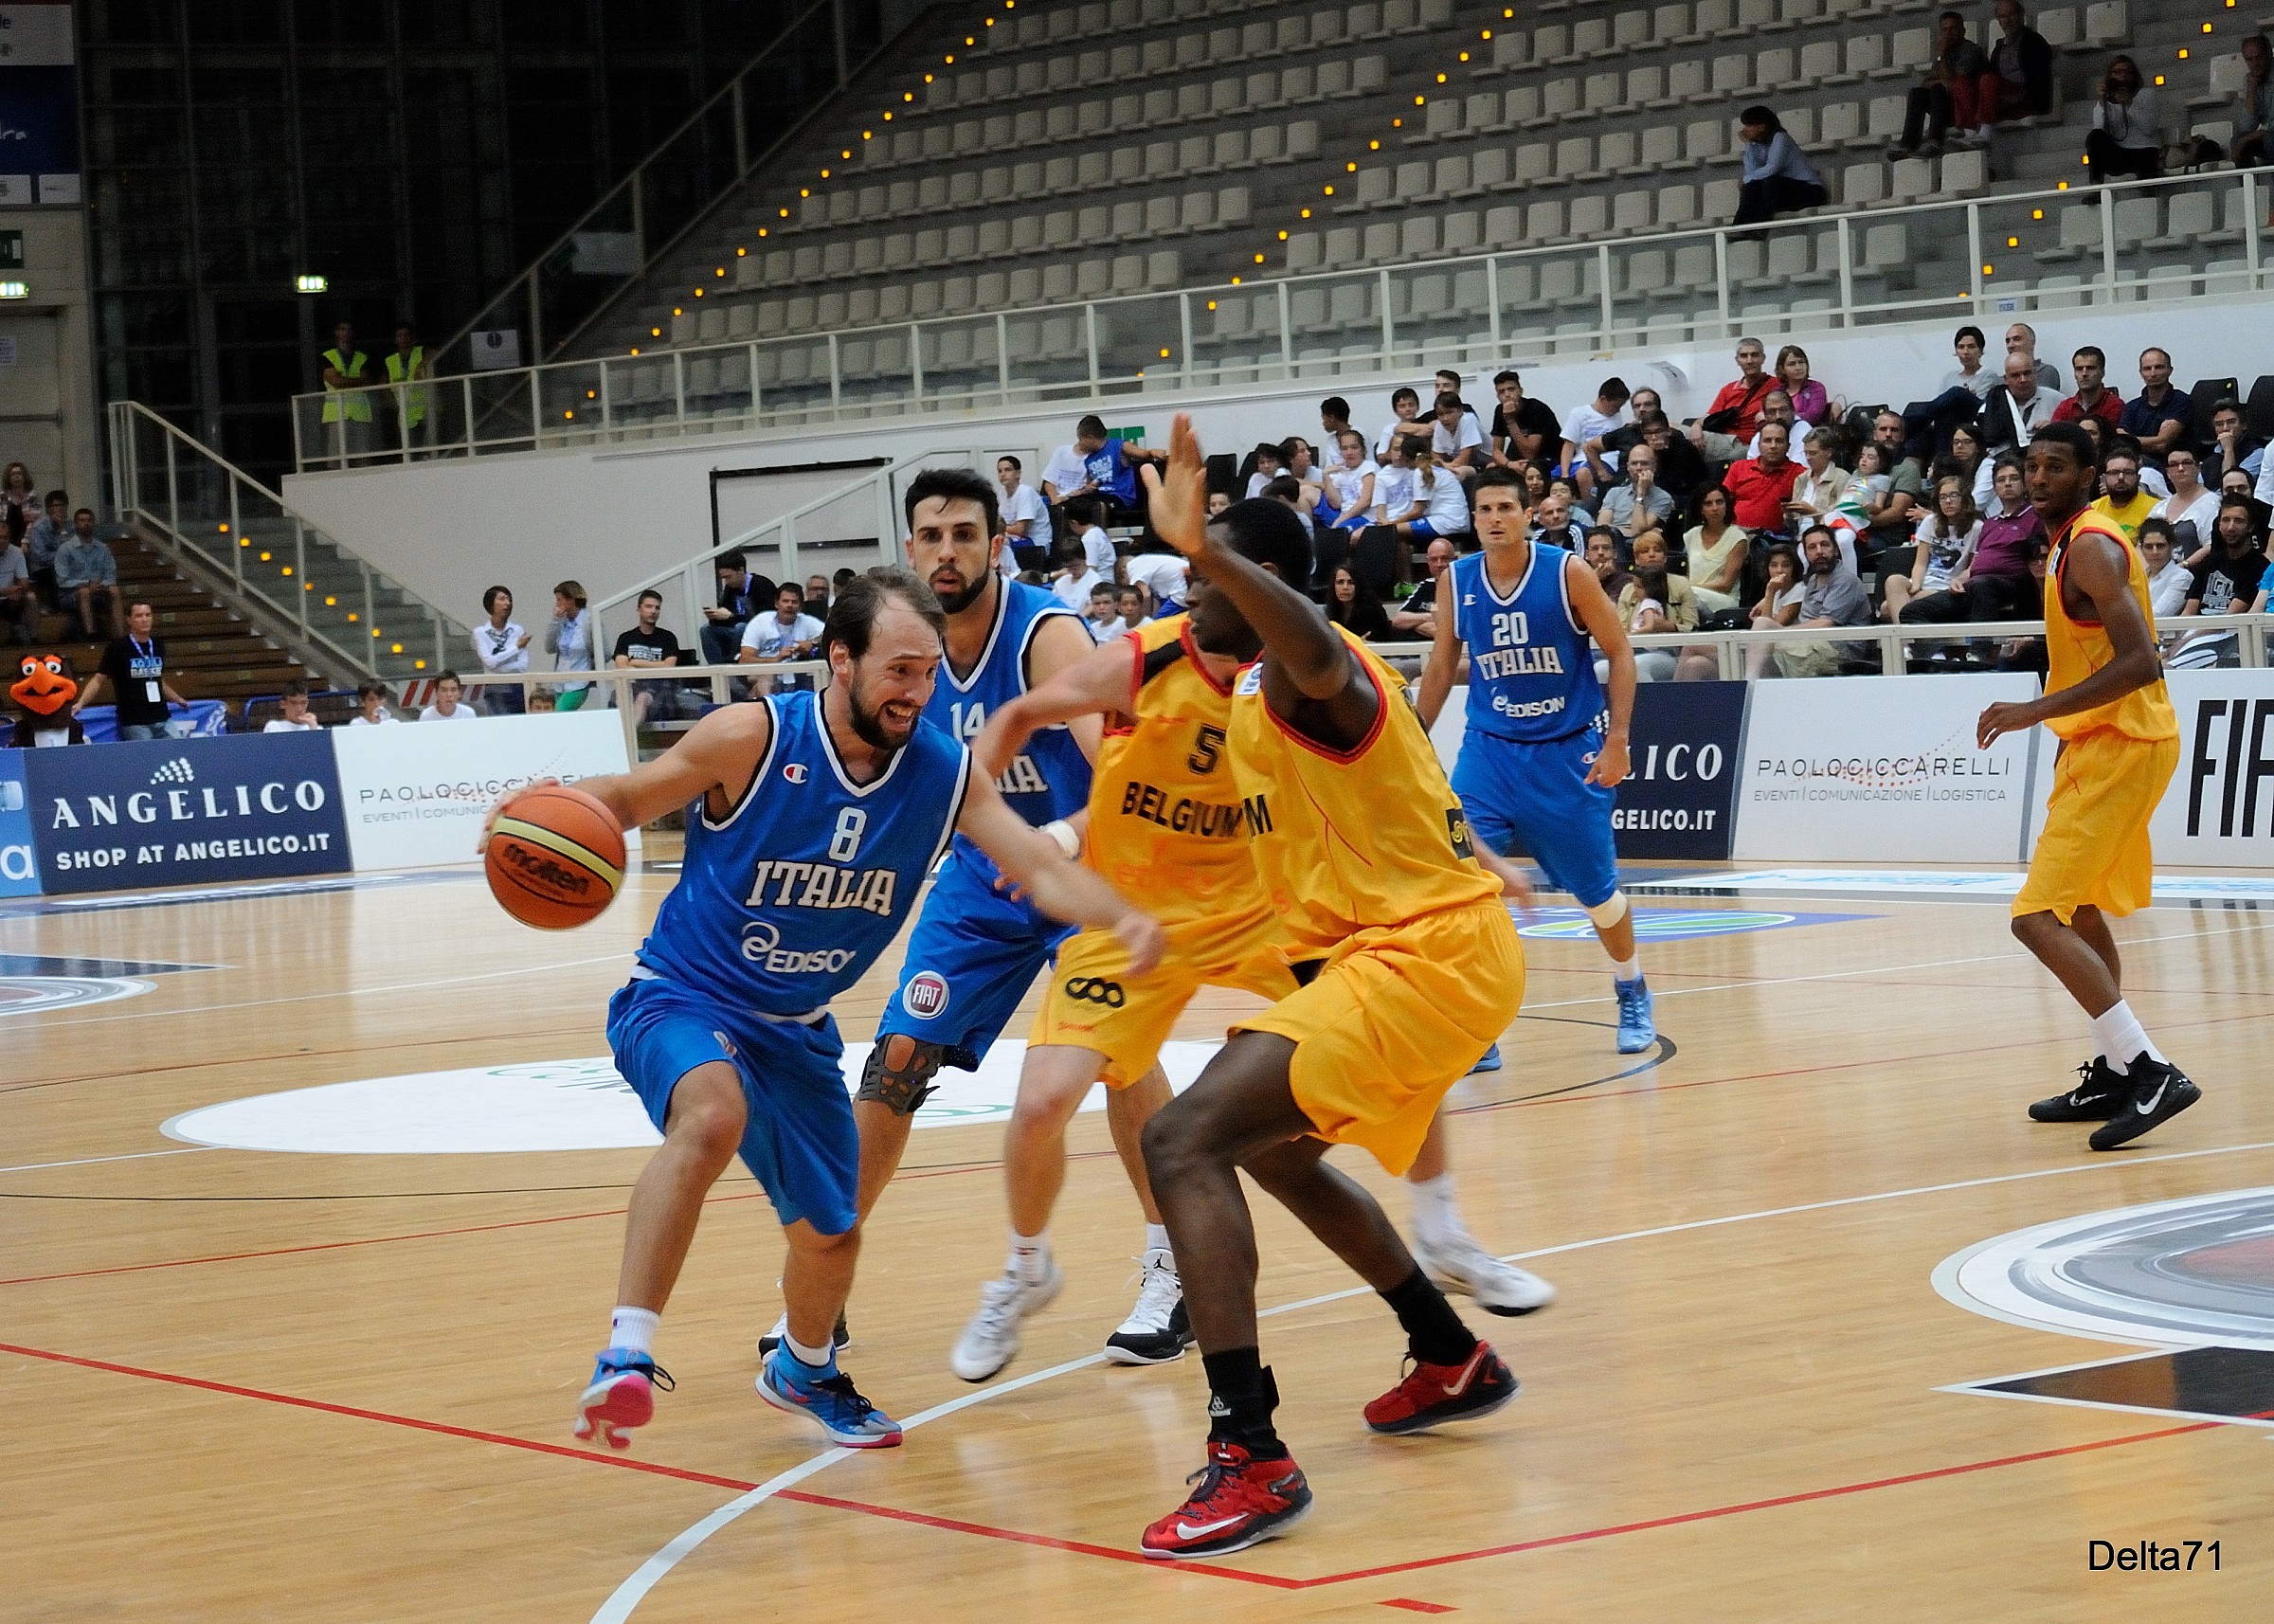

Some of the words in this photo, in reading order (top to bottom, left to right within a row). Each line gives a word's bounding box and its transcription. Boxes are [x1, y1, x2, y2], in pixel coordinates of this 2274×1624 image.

[1490, 611, 1529, 647] 20
[1474, 646, 1564, 681] ITALIA
[949, 701, 986, 743] 14
[1505, 695, 1566, 718] EDISON
[1187, 722, 1227, 776] 5
[1757, 757, 2011, 778] PAOLOCICCARELLI
[52, 779, 326, 829] ANGELICO
[1121, 781, 1243, 838] BELGIUM
[1754, 788, 1799, 803] EVENTI
[1808, 787, 1922, 803] COMUNICAZIONE
[1932, 788, 2007, 803] LOGISTICA
[363, 809, 413, 824] EVENTI
[828, 805, 868, 863] 8
[1611, 808, 1717, 831] GELICO.IT
[56, 847, 127, 871] SHOP
[136, 845, 165, 865] AT
[174, 832, 331, 862] ANGELICO.IT
[745, 859, 897, 917] ITALIA
[911, 983, 941, 1008] FIAT
